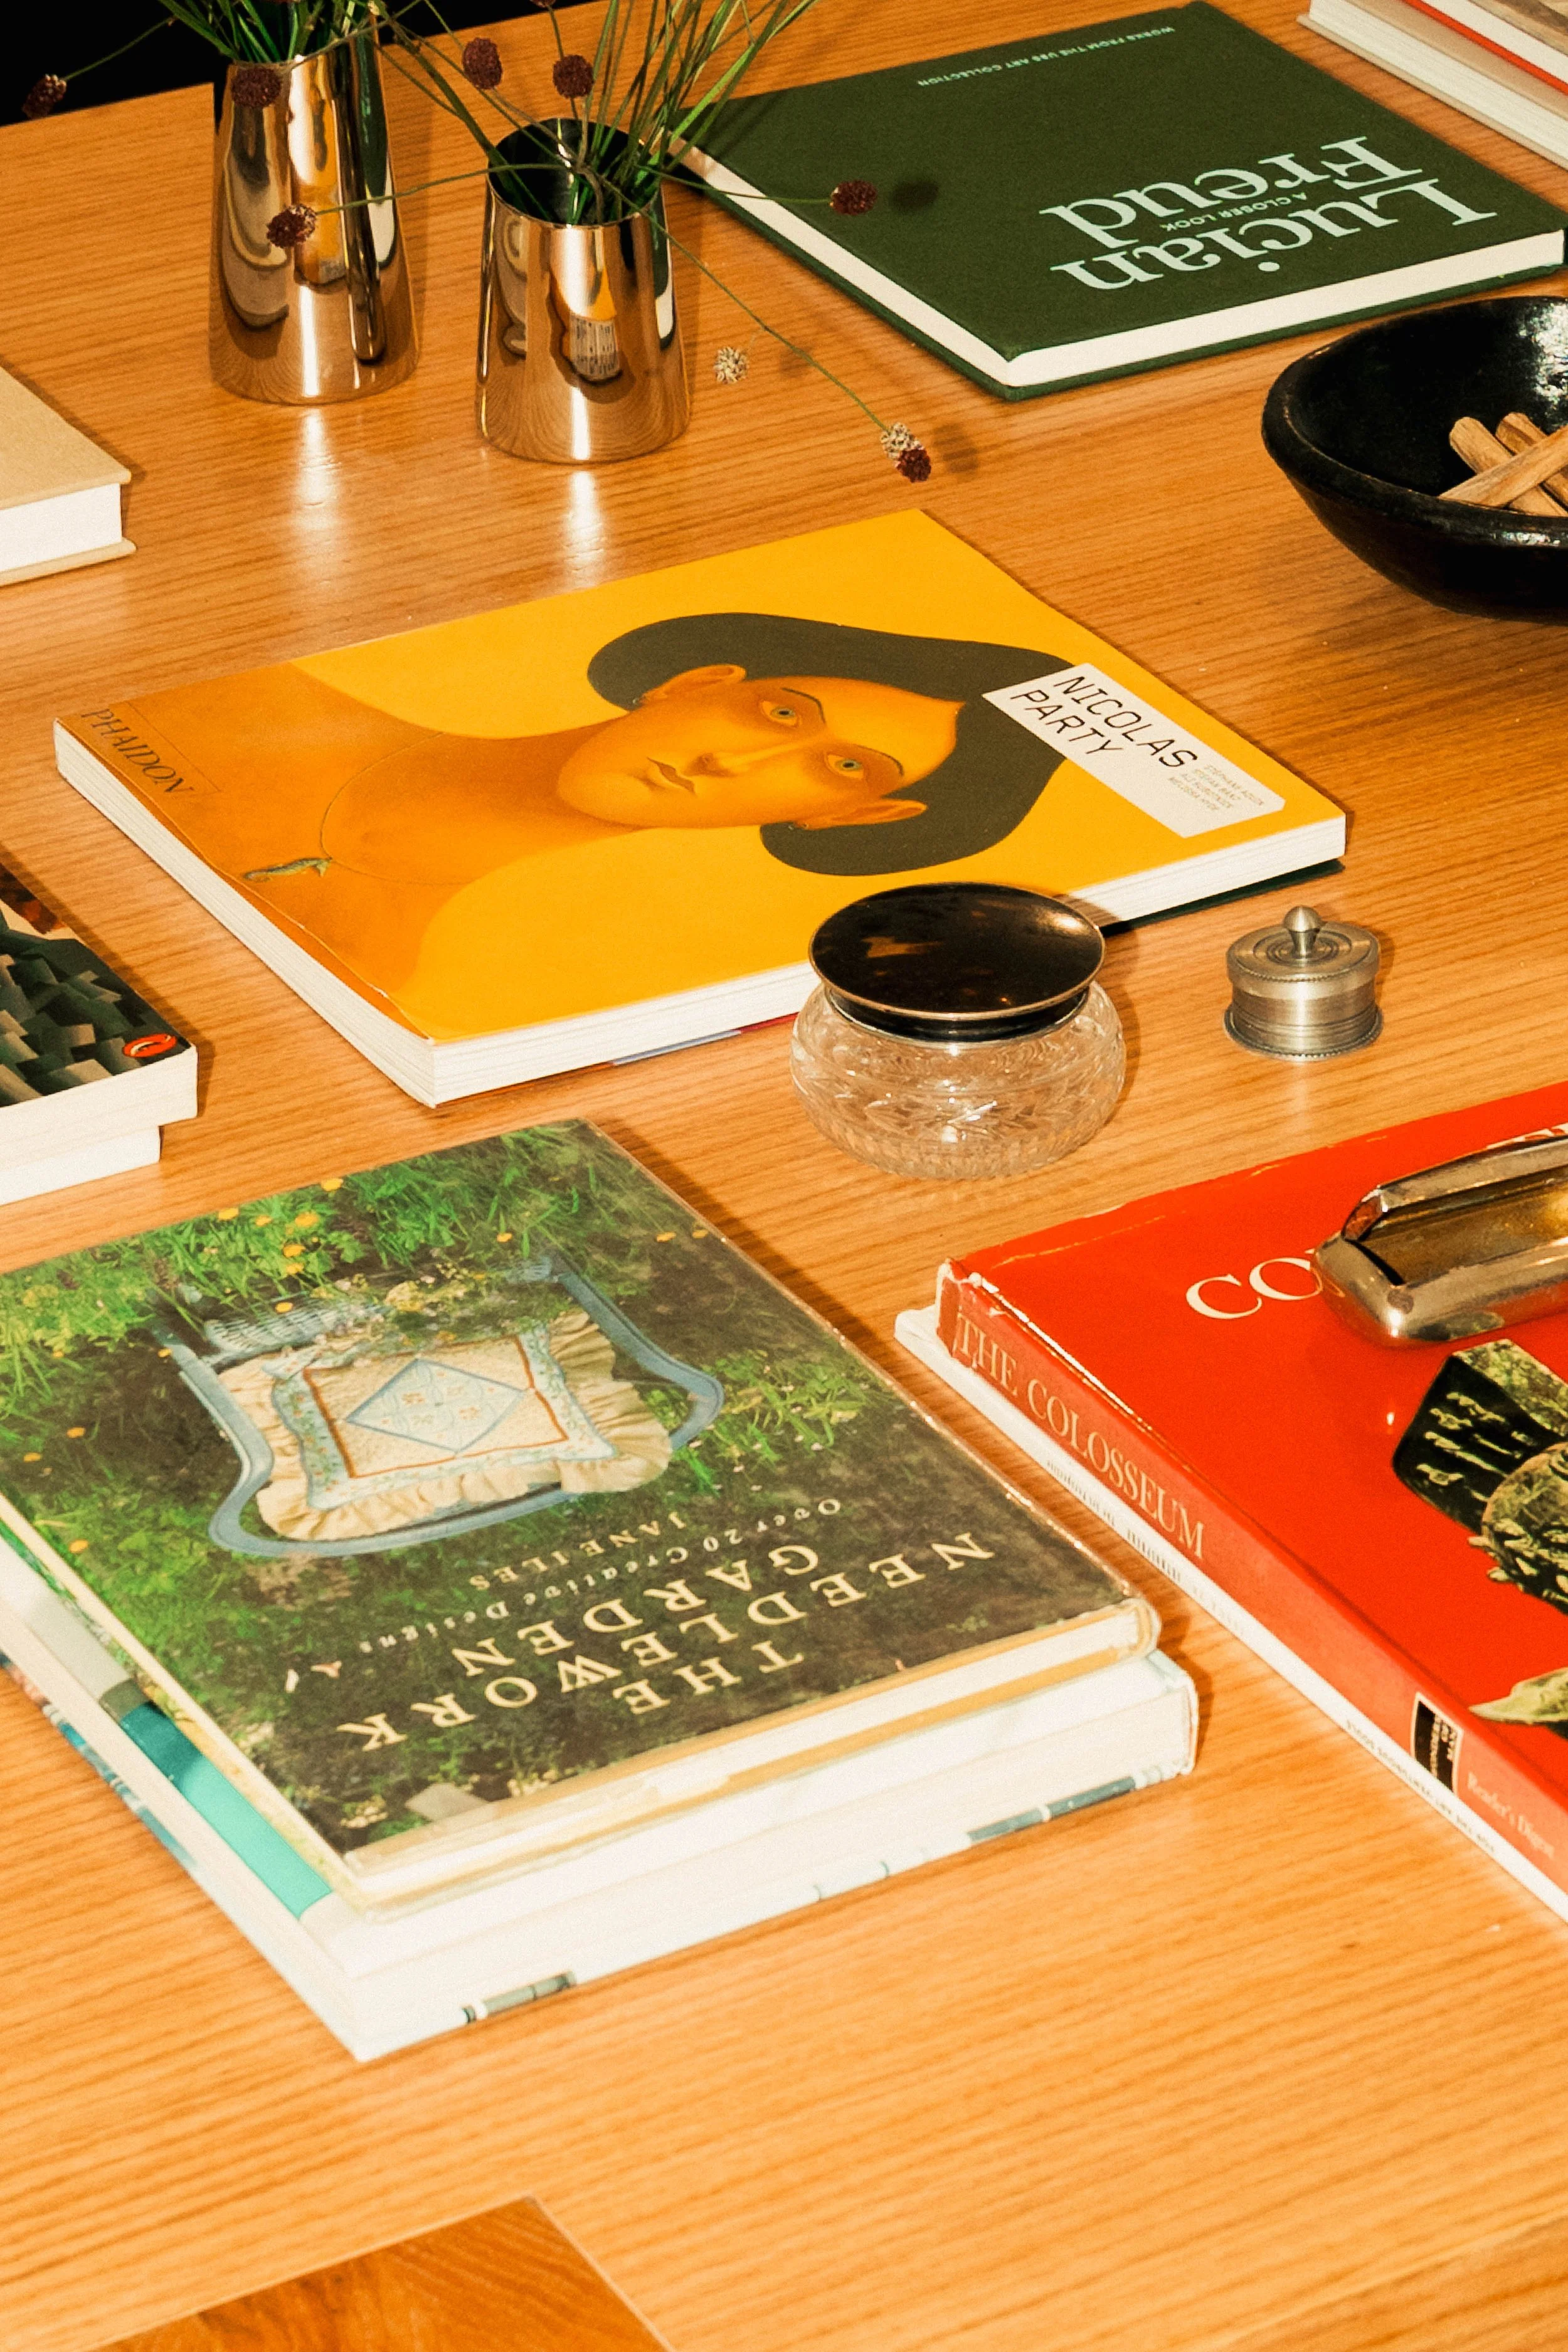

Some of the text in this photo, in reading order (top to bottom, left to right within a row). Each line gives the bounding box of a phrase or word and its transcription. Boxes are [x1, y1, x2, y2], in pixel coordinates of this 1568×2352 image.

[1005, 58, 1029, 69] ART
[1058, 46, 1087, 56] THE
[1086, 37, 1125, 50] FROM
[1125, 26, 1175, 41] WORKS
[918, 64, 1003, 87] COLLECTION
[1039, 136, 1422, 249] Freud
[1160, 192, 1307, 232] A CLOSER LOOK
[1050, 178, 1498, 290] Lucian
[81, 708, 194, 793] PHAIDON
[1010, 689, 1124, 755] PARTY
[1054, 676, 1197, 768] NICOLAS
[958, 1313, 1018, 1396] THE
[1027, 1378, 1204, 1560] COLOSSEUM
[359, 1499, 841, 1654] Over 20 Creative Designs
[469, 1512, 687, 1591] JANE ILES
[338, 1532, 995, 1752] NEEDLEWORK
[452, 1544, 818, 1677] GARDEN
[613, 1640, 803, 1715] THE
